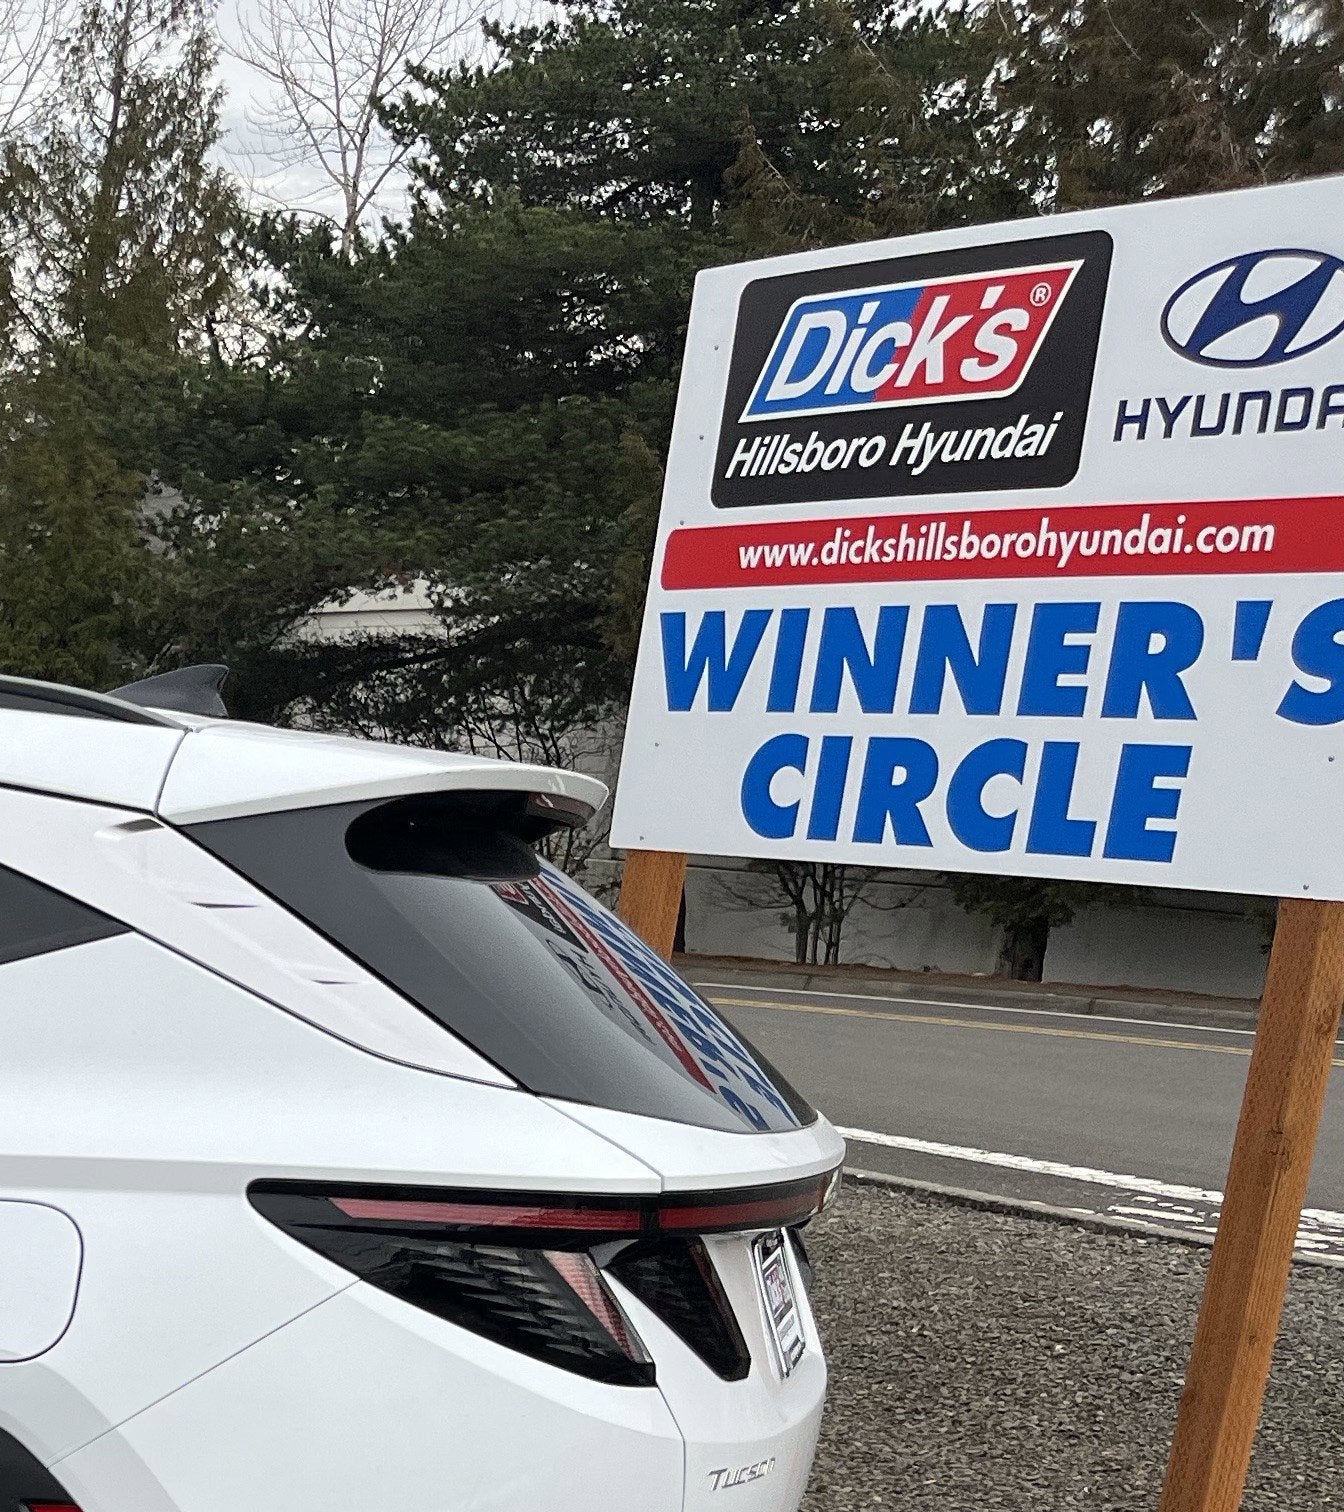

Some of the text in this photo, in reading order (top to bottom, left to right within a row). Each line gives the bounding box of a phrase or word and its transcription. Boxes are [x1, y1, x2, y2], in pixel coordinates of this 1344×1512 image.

[765, 285, 1030, 401] Dick's
[725, 411, 1064, 478] Hillsboro Hyundai
[1113, 384, 1344, 442] HYUNDA
[738, 513, 1276, 569] www.dickshillsborohyundai.com
[659, 599, 1344, 726] WINNER'S
[741, 732, 1193, 863] CIRCLE
